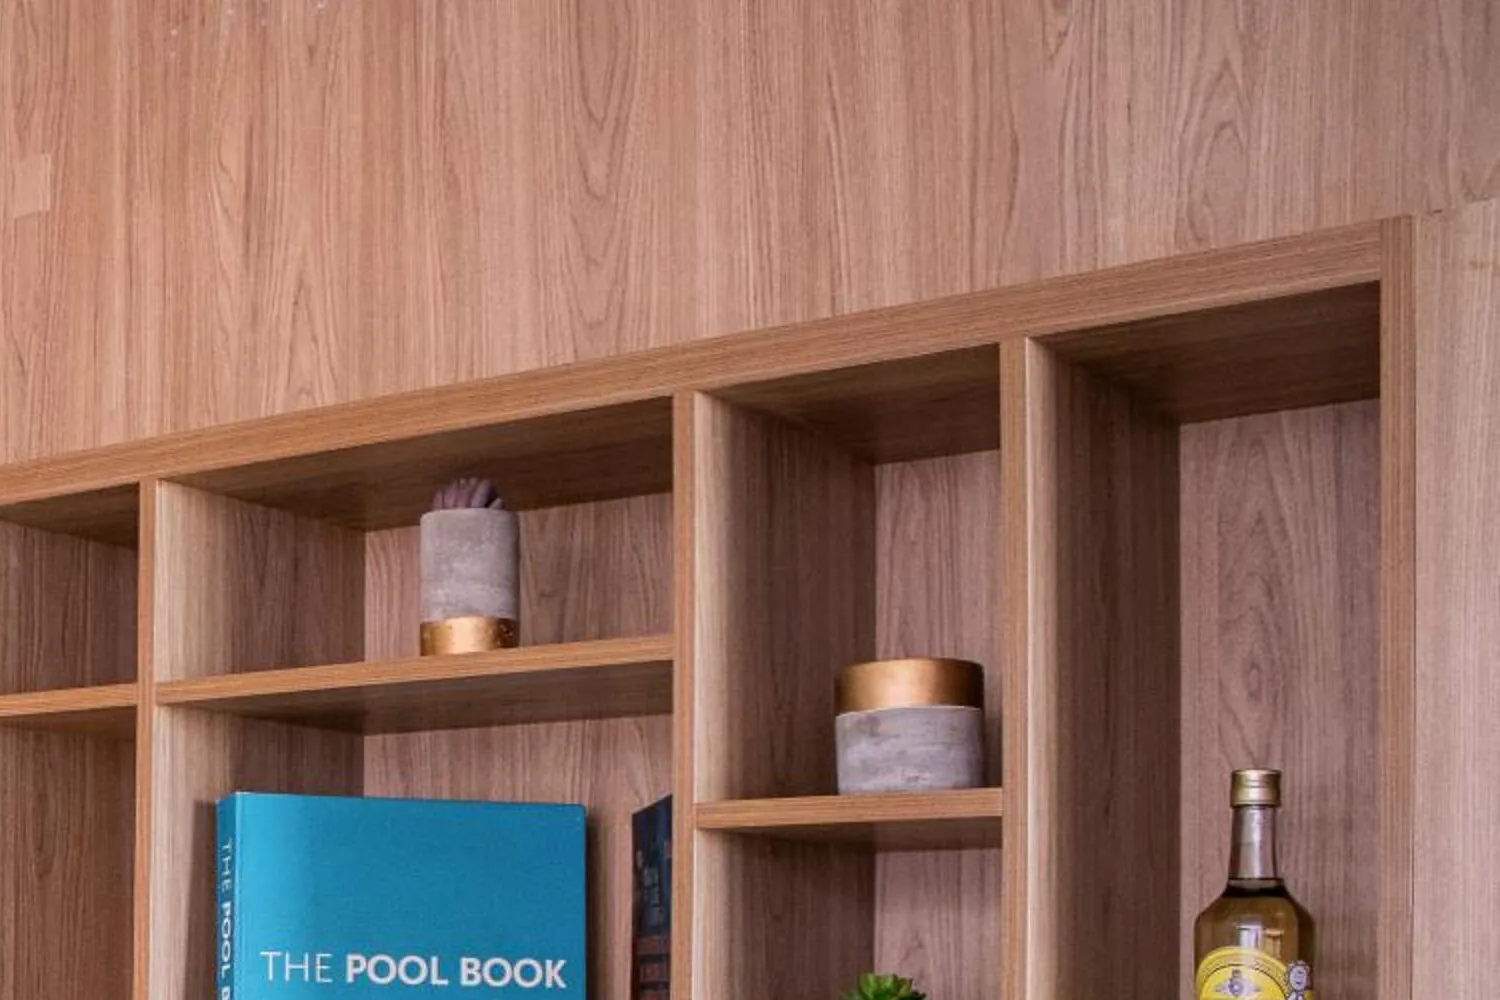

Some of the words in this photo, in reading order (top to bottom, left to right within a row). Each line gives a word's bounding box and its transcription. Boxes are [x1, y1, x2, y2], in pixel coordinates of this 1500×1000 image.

[222, 838, 232, 891] THE
[221, 902, 232, 978] POOL
[259, 950, 333, 983] THE
[345, 954, 448, 986] POOL
[459, 957, 566, 988] BOOK
